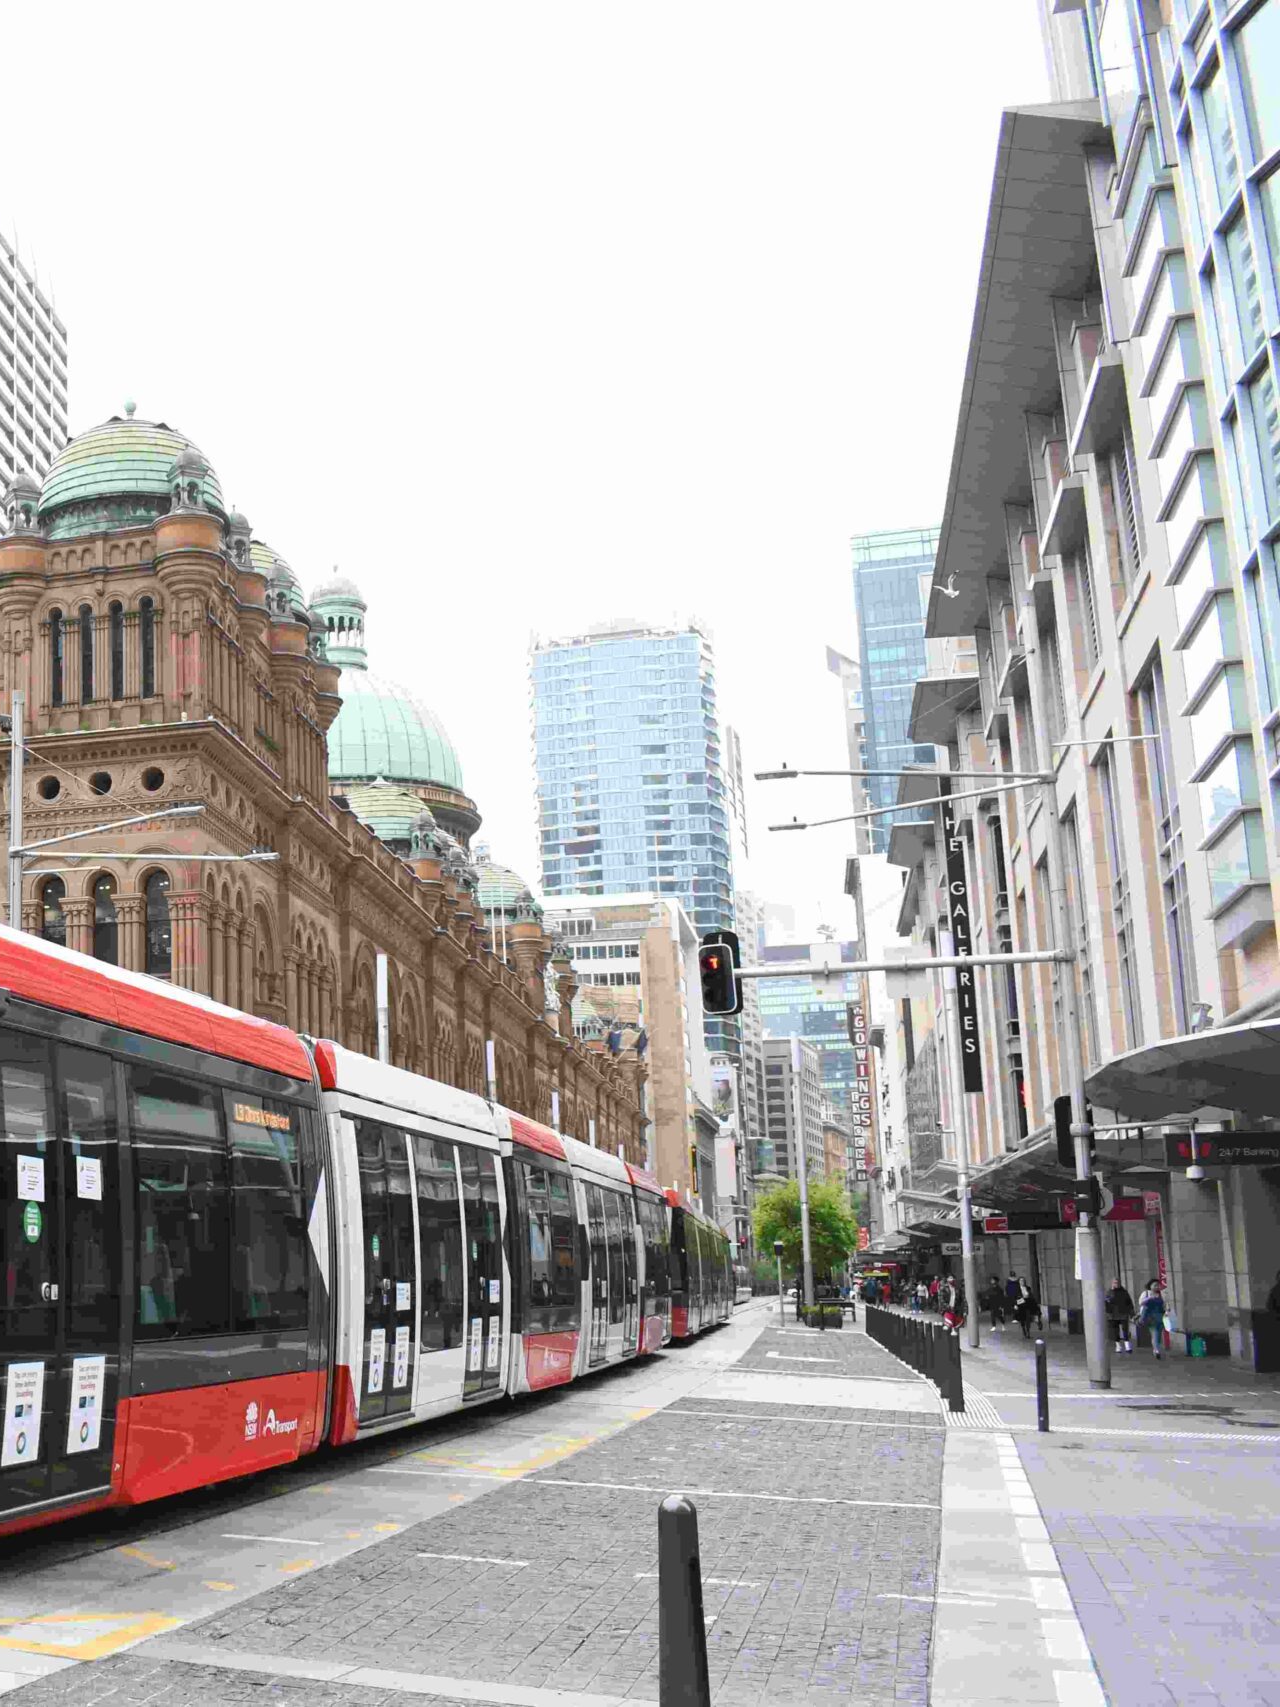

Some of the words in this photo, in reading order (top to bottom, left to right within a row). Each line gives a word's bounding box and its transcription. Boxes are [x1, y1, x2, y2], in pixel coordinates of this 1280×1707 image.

[945, 795, 960, 851] HE
[950, 881, 976, 1053] GALERIES
[854, 1015, 871, 1126] GOWINGS
[275, 1417, 298, 1434] Transport
